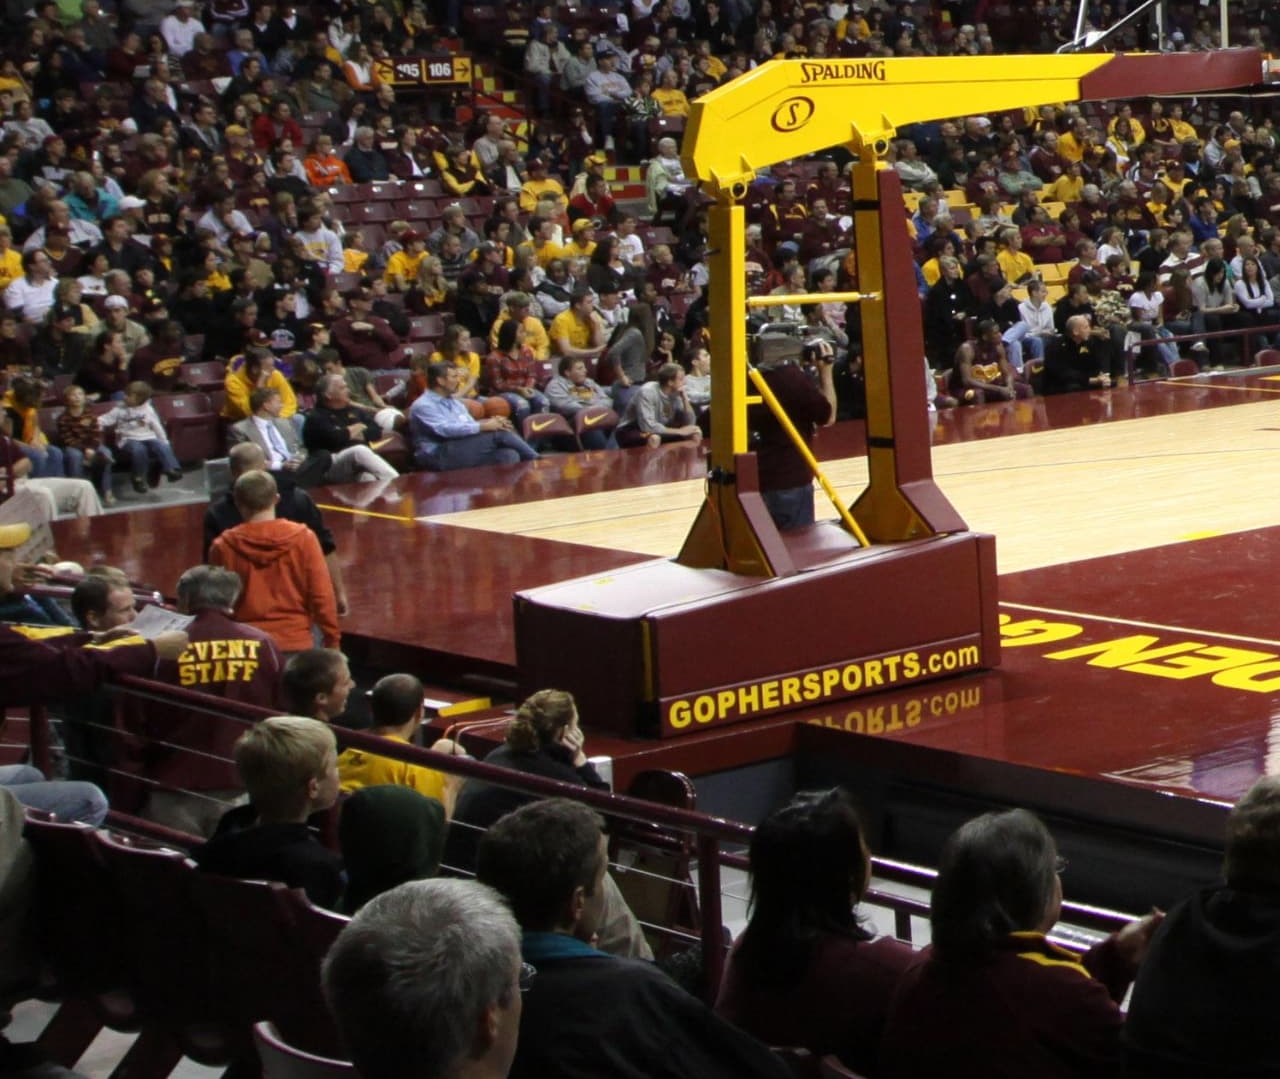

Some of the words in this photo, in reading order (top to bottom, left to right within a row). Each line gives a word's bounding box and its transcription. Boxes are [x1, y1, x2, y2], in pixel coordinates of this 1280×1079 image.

[429, 63, 452, 77] 106
[800, 60, 885, 84] SPALDING
[179, 660, 259, 685] STAFF
[669, 645, 980, 729] GOPHERSPORTS.com
